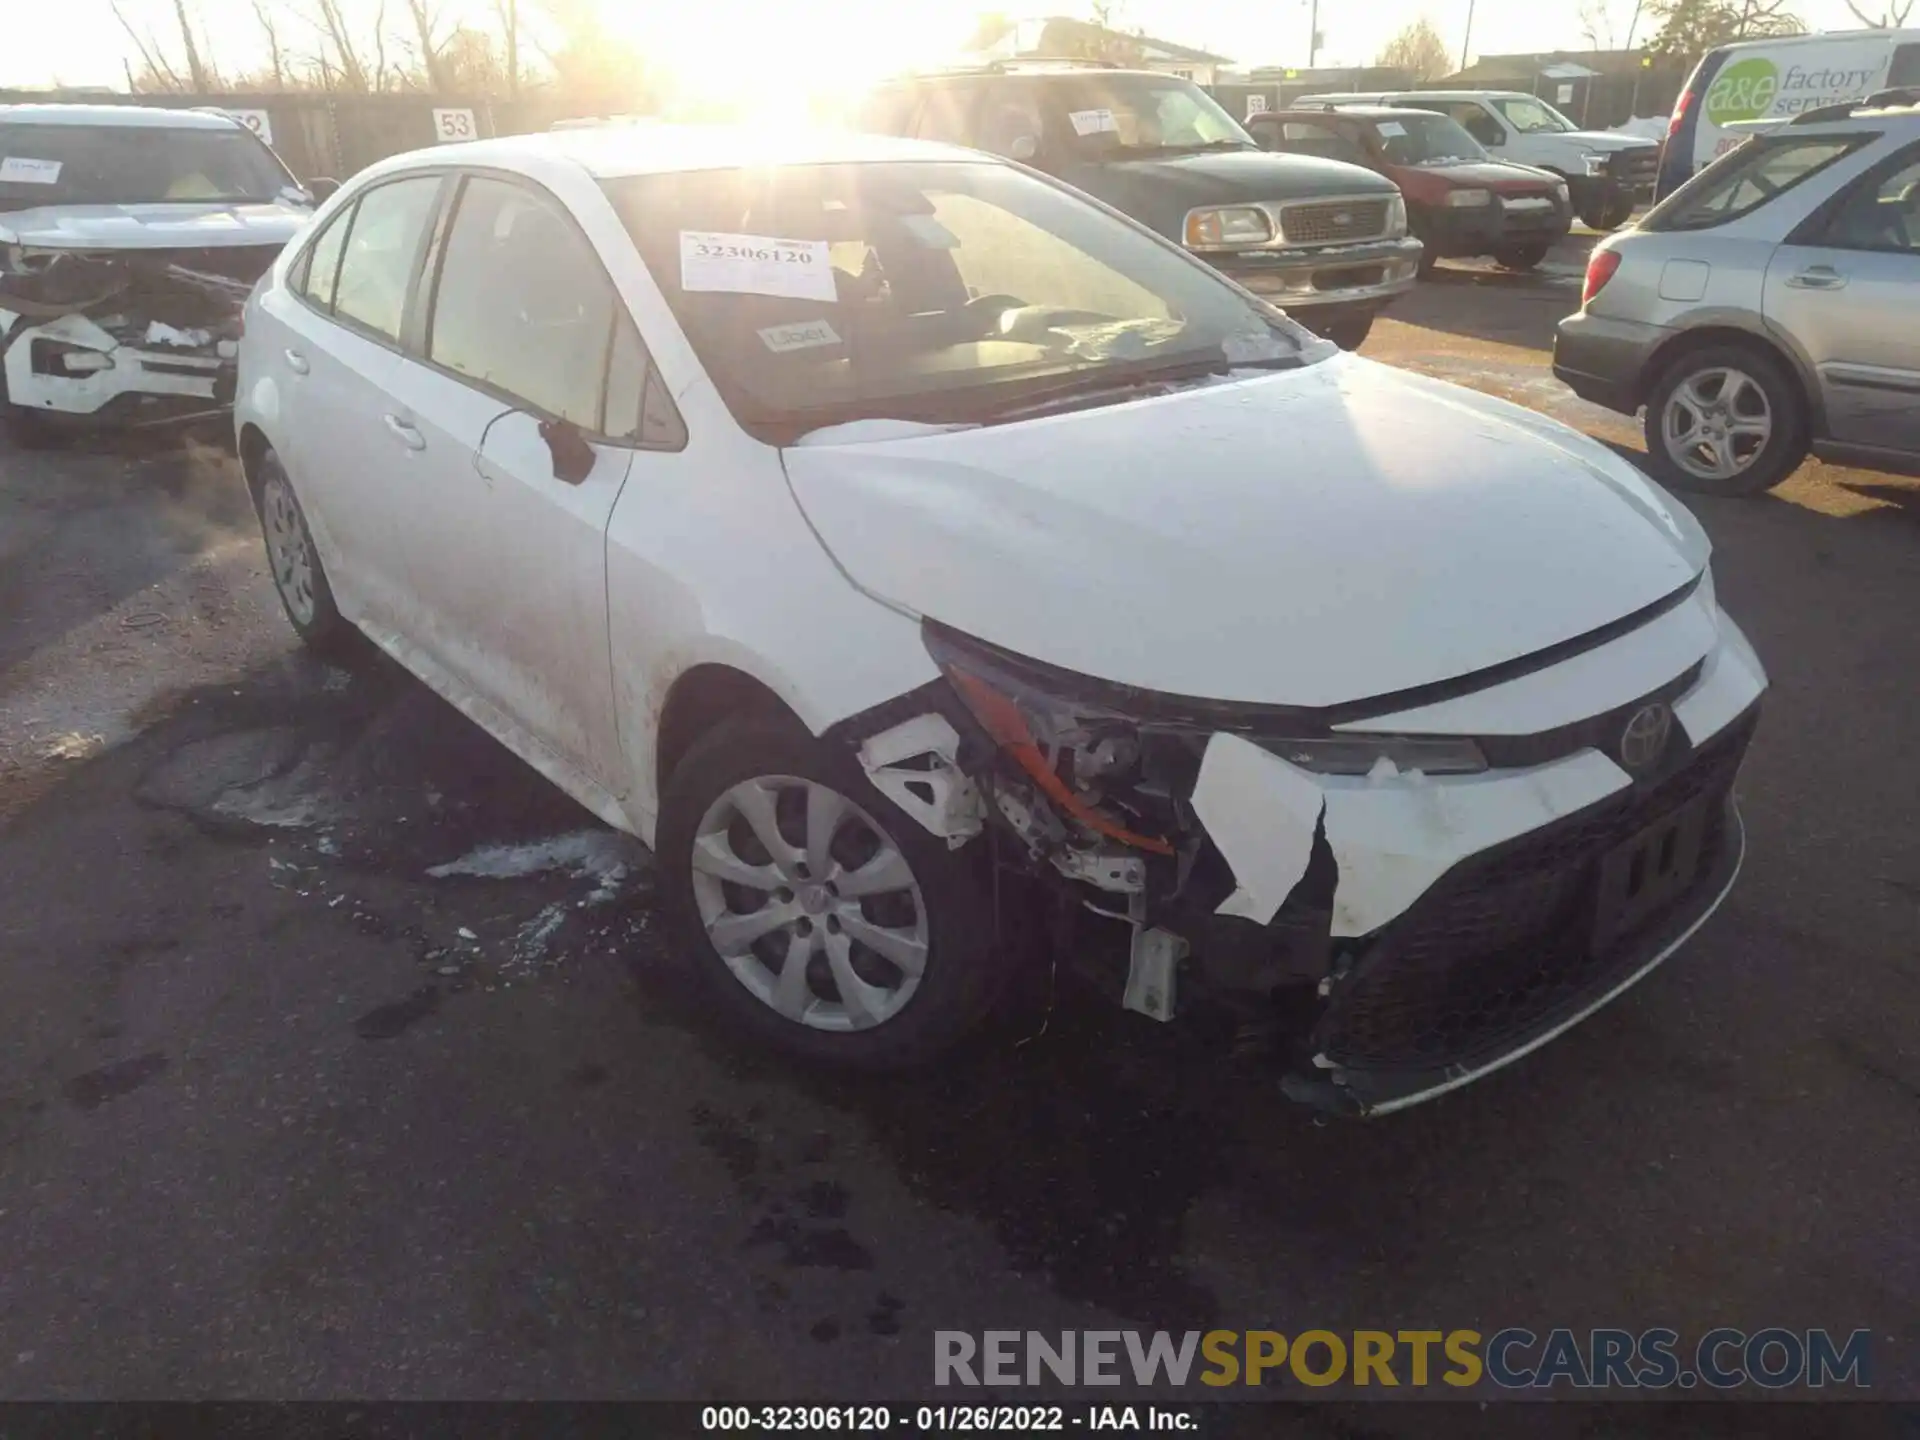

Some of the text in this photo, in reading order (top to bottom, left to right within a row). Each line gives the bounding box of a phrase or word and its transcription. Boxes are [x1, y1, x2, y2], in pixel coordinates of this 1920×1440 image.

[1782, 65, 1874, 91] factory
[1707, 76, 1776, 112] a&e
[441, 113, 470, 136] 53
[695, 243, 813, 264] 32306120
